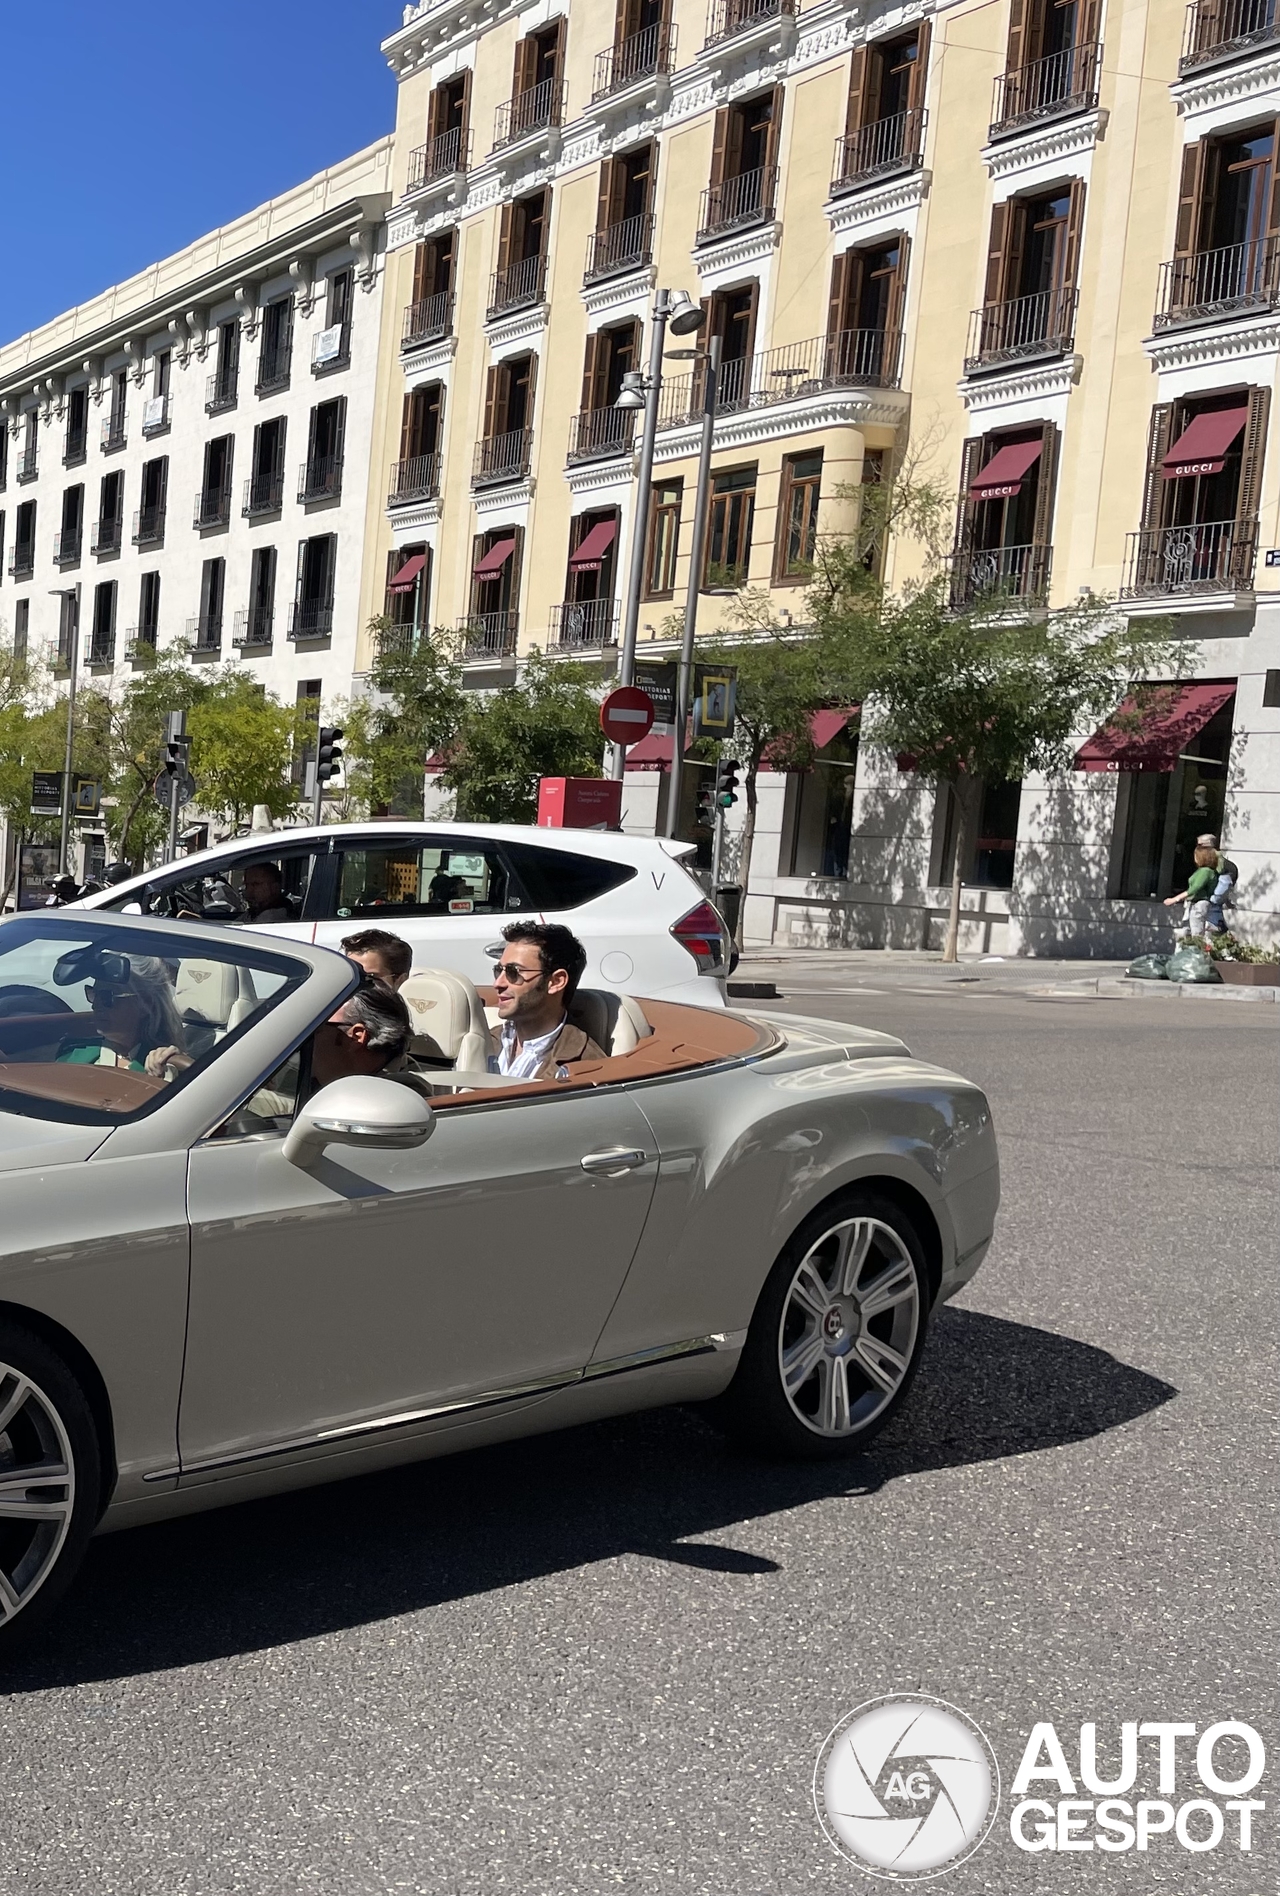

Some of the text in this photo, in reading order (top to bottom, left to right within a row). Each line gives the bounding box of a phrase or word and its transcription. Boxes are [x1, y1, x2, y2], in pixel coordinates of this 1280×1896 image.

[1176, 463, 1212, 475] GUCCI
[981, 486, 1012, 498] GUCCI
[578, 562, 597, 570] GUCCI
[651, 871, 666, 891] V
